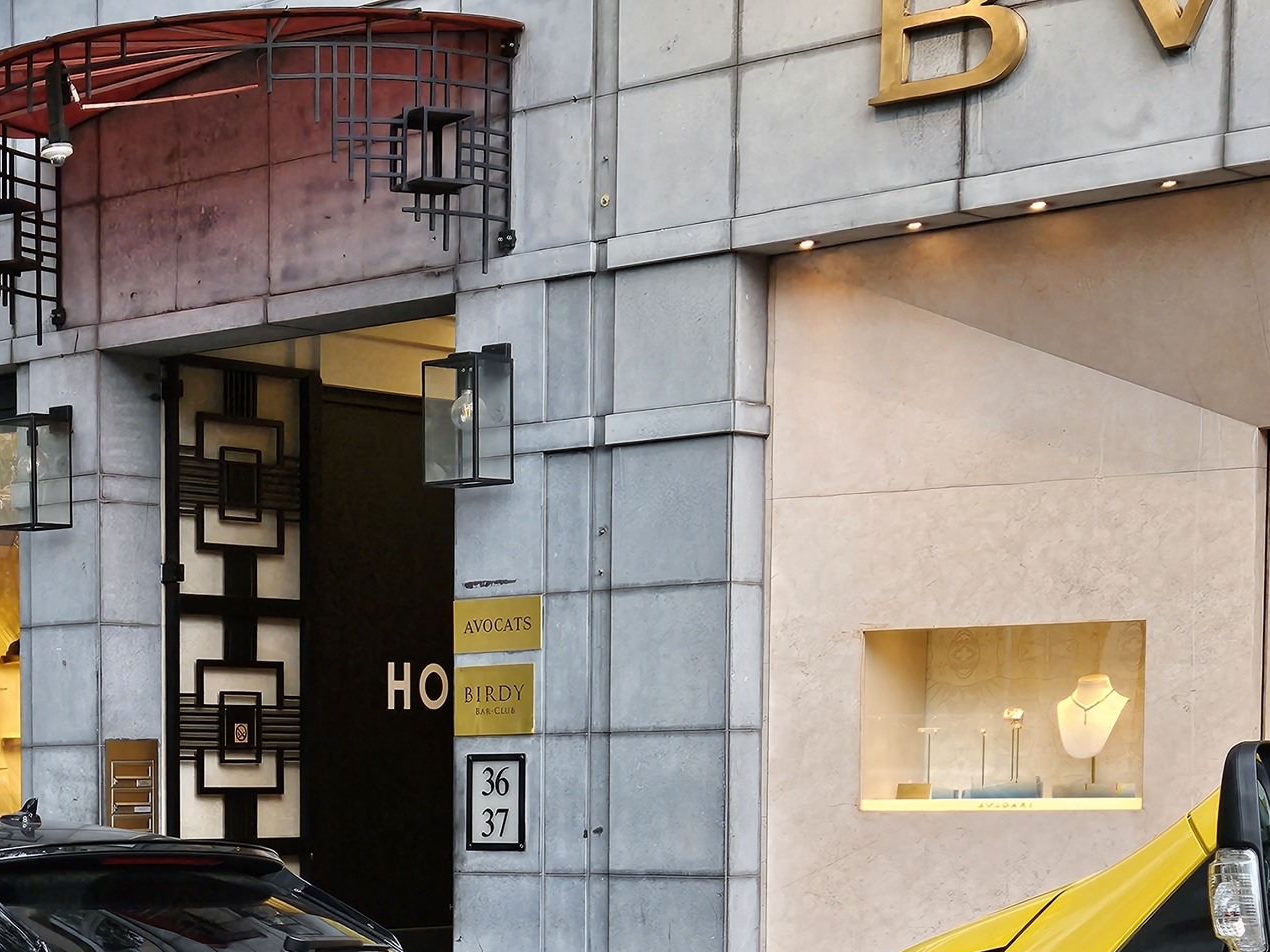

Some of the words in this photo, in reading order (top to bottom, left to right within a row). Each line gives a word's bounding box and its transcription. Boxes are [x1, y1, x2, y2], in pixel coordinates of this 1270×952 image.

[463, 616, 532, 635] AVOCATS
[387, 661, 449, 710] HO
[464, 684, 525, 703] BIRDY
[481, 766, 510, 796] 36
[481, 808, 510, 837] 37
